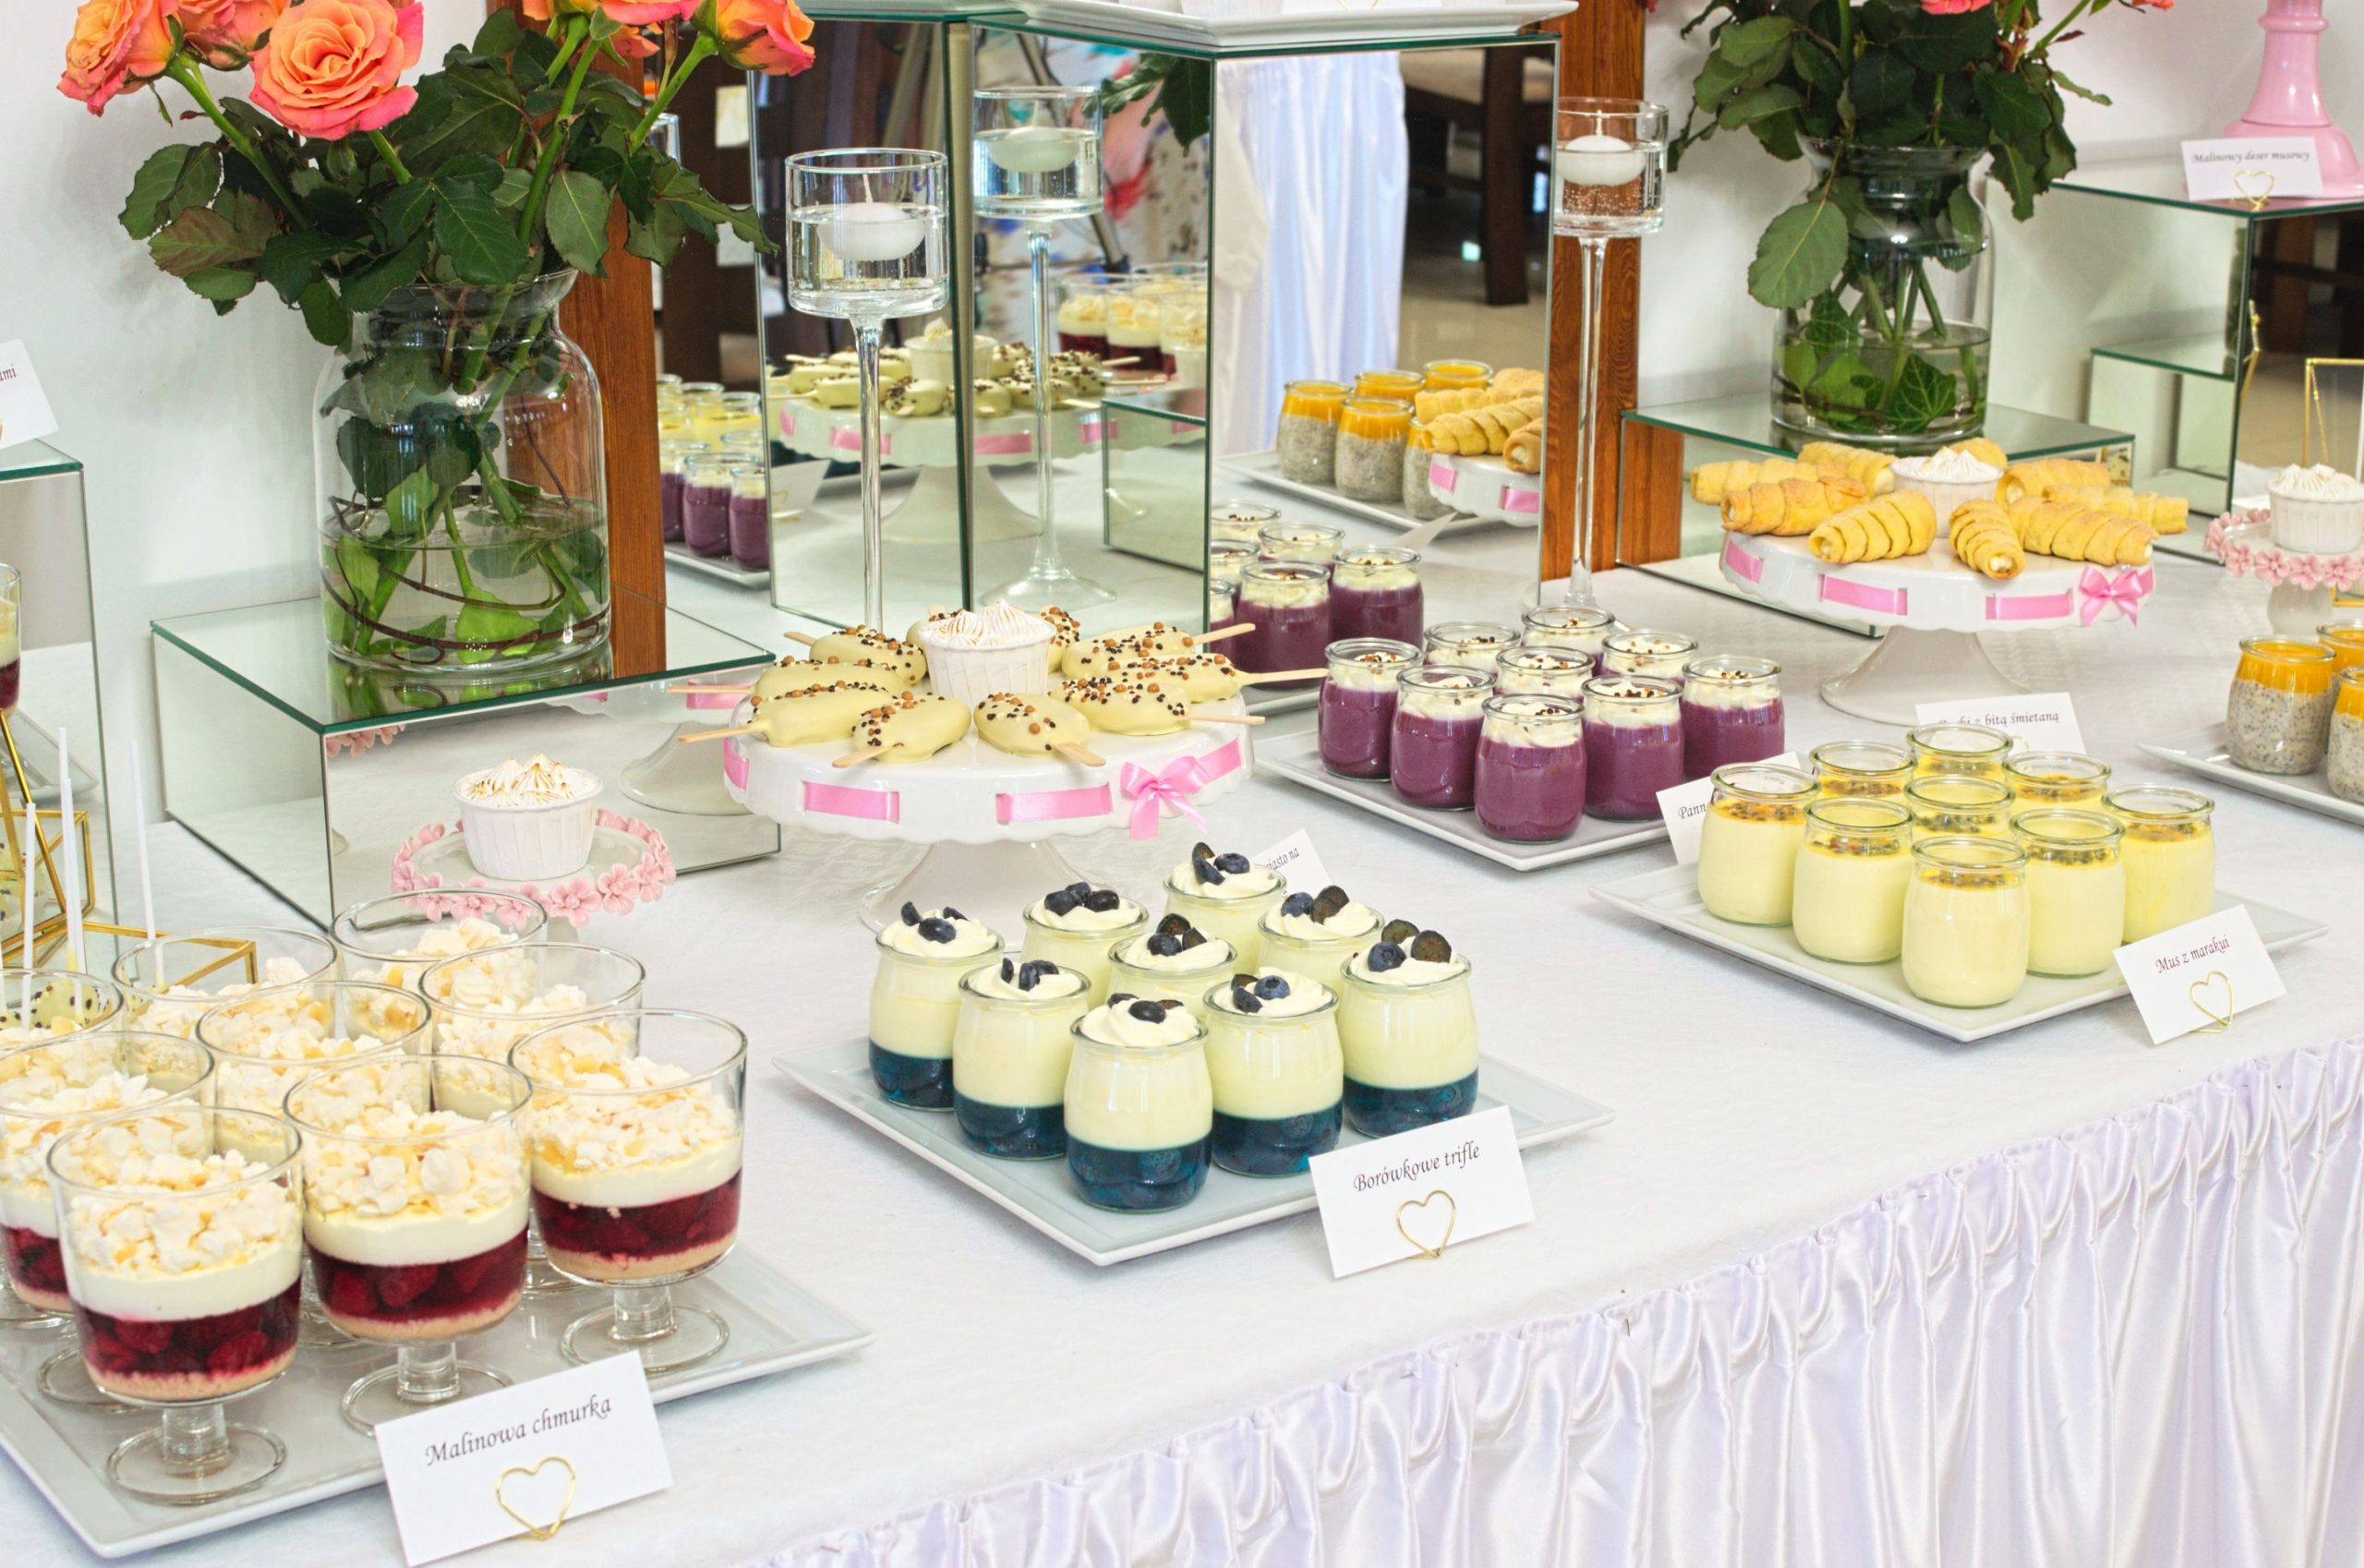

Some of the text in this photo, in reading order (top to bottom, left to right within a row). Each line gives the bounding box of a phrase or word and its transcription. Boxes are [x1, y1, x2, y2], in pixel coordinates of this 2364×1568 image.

[2192, 151, 2242, 164] Malinowy
[1985, 714, 2008, 727] bitą
[2010, 712, 2059, 724] śmietaną
[1678, 802, 1707, 819] Pann
[1266, 847, 1300, 870] iasto na
[2154, 935, 2230, 973] Mus z marakui
[1353, 1140, 1479, 1191] Borówkowe trifle
[425, 1393, 612, 1465] Malinowa chmurka
